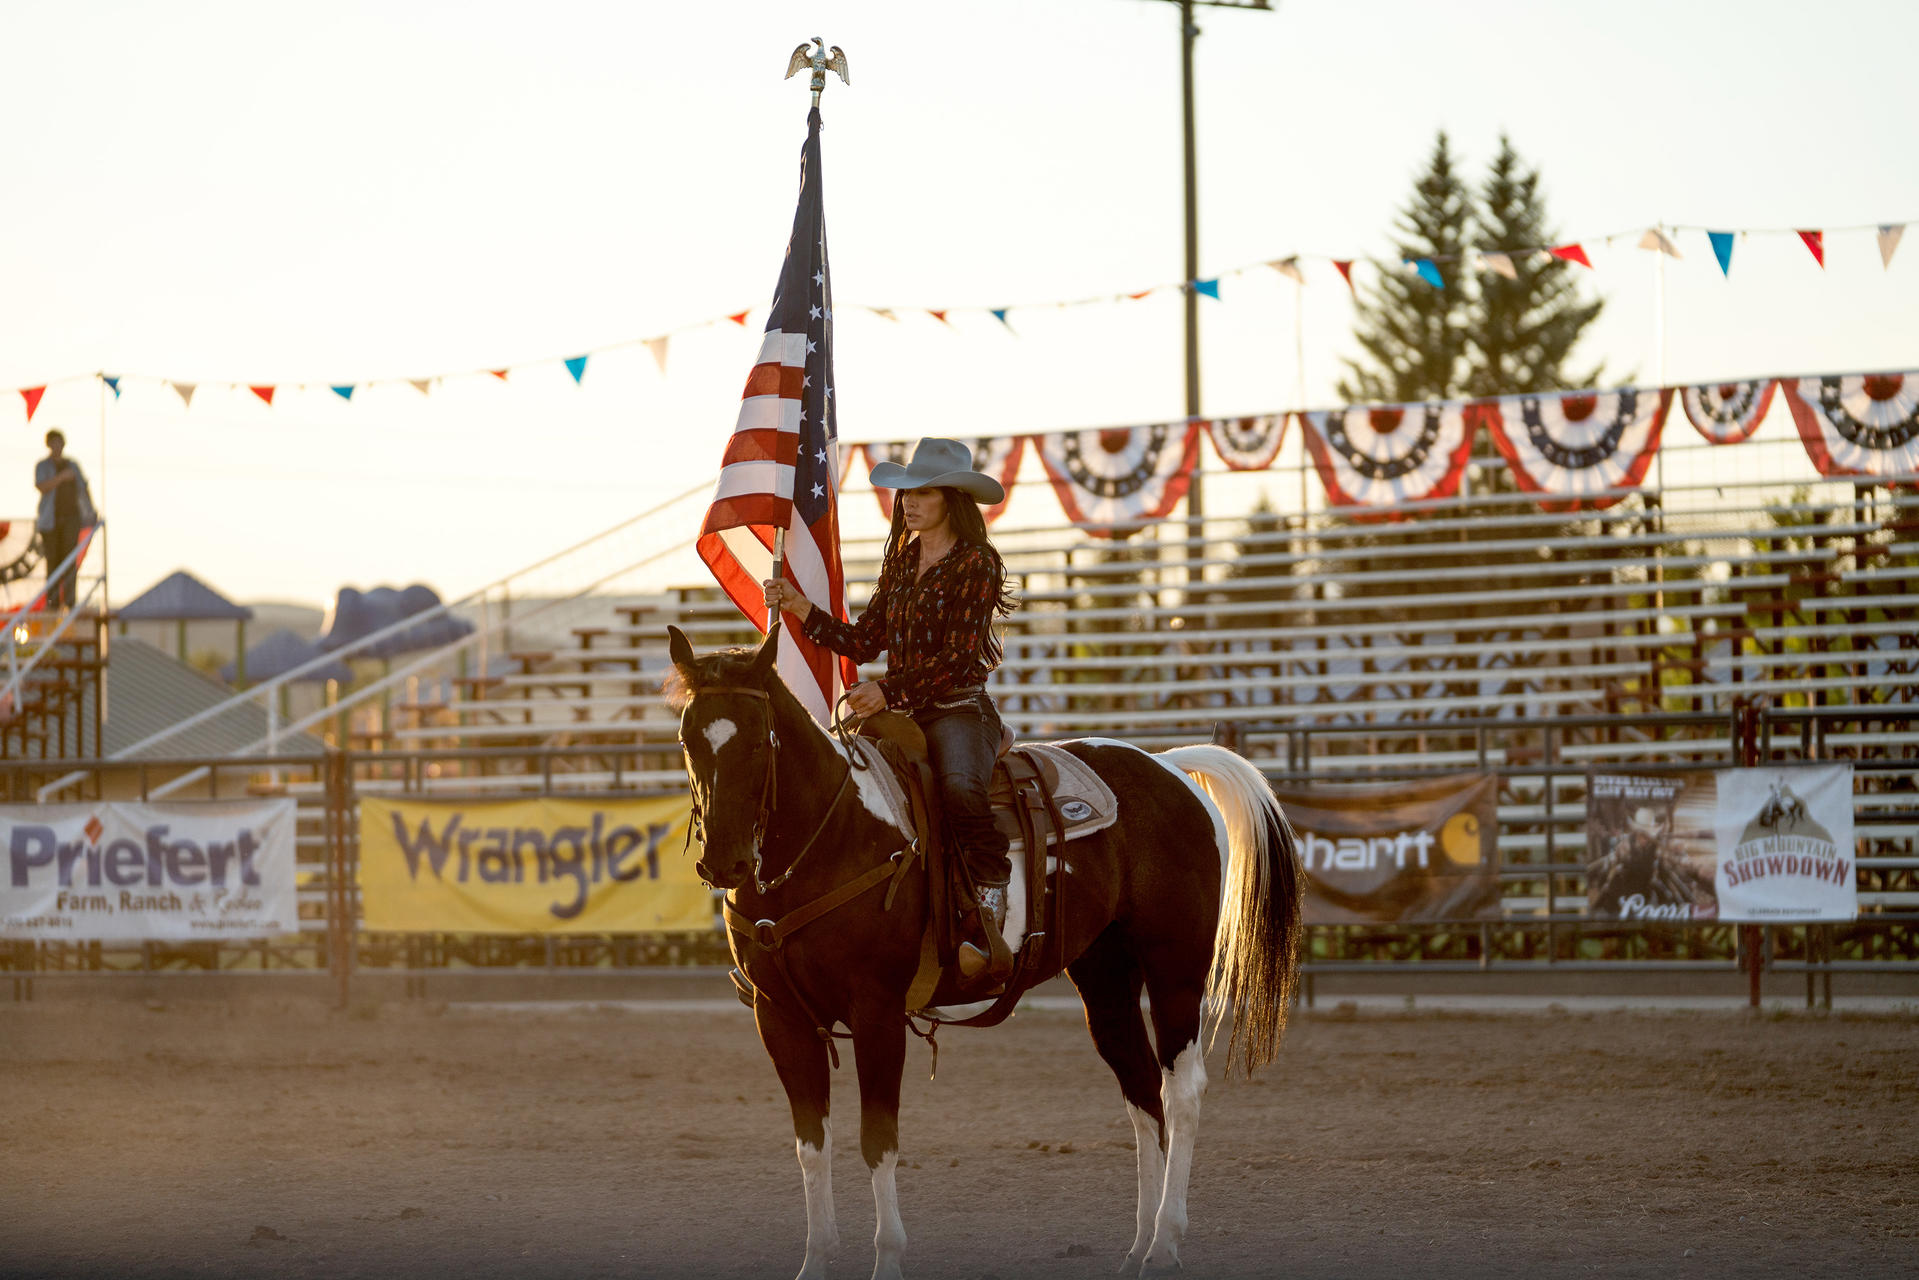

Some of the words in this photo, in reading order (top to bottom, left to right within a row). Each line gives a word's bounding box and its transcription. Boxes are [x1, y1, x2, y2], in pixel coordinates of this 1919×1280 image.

[1624, 786, 1649, 798] WAY
[1651, 786, 1675, 799] OUT
[10, 816, 261, 887] Priefert
[1763, 838, 1838, 860] MOUNTAIN
[390, 811, 672, 920] Wrangler
[1723, 855, 1850, 888] SHOWDOWN
[56, 891, 114, 914] Farm,
[119, 891, 182, 912] Ranch
